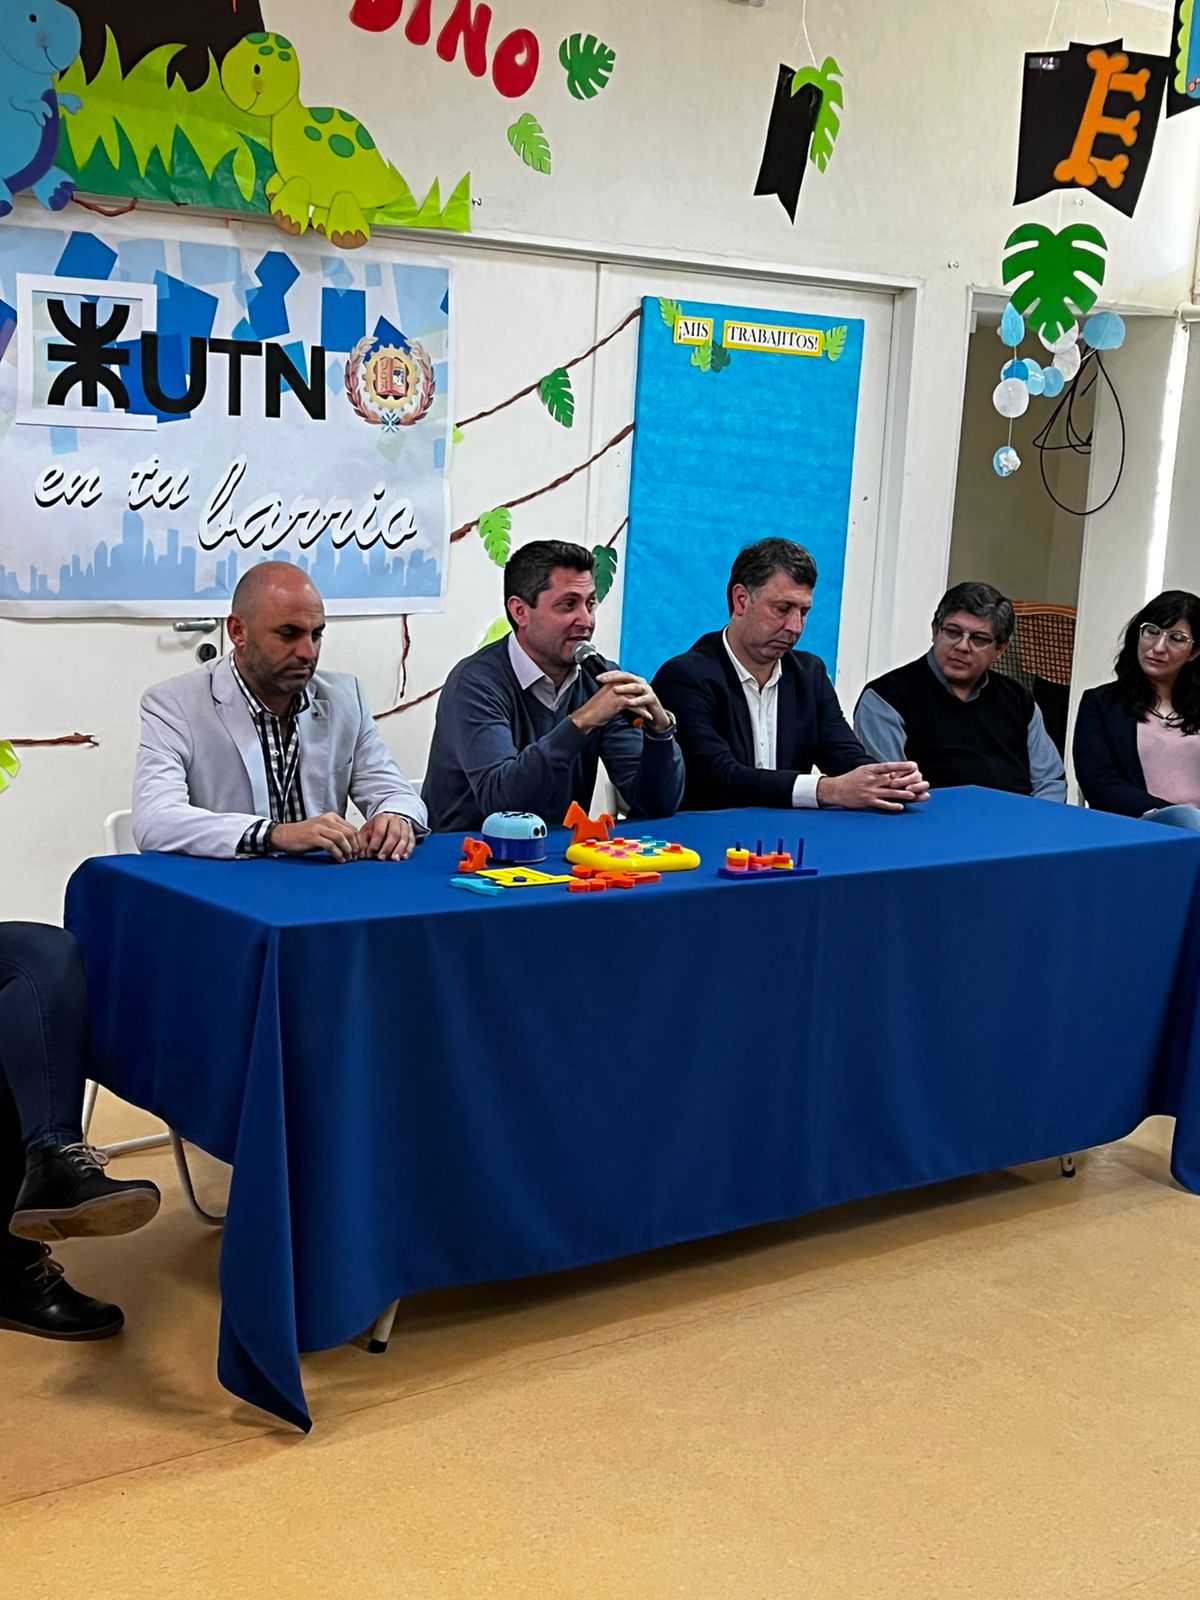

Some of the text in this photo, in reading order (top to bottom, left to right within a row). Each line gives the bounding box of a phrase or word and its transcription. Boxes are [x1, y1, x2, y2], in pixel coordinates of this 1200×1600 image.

[1054, 49, 1150, 189] E
[141, 331, 326, 421] UTN
[678, 321, 818, 350] ¡MIS TRABAJITOS!
[34, 454, 418, 551] en tu barrio
